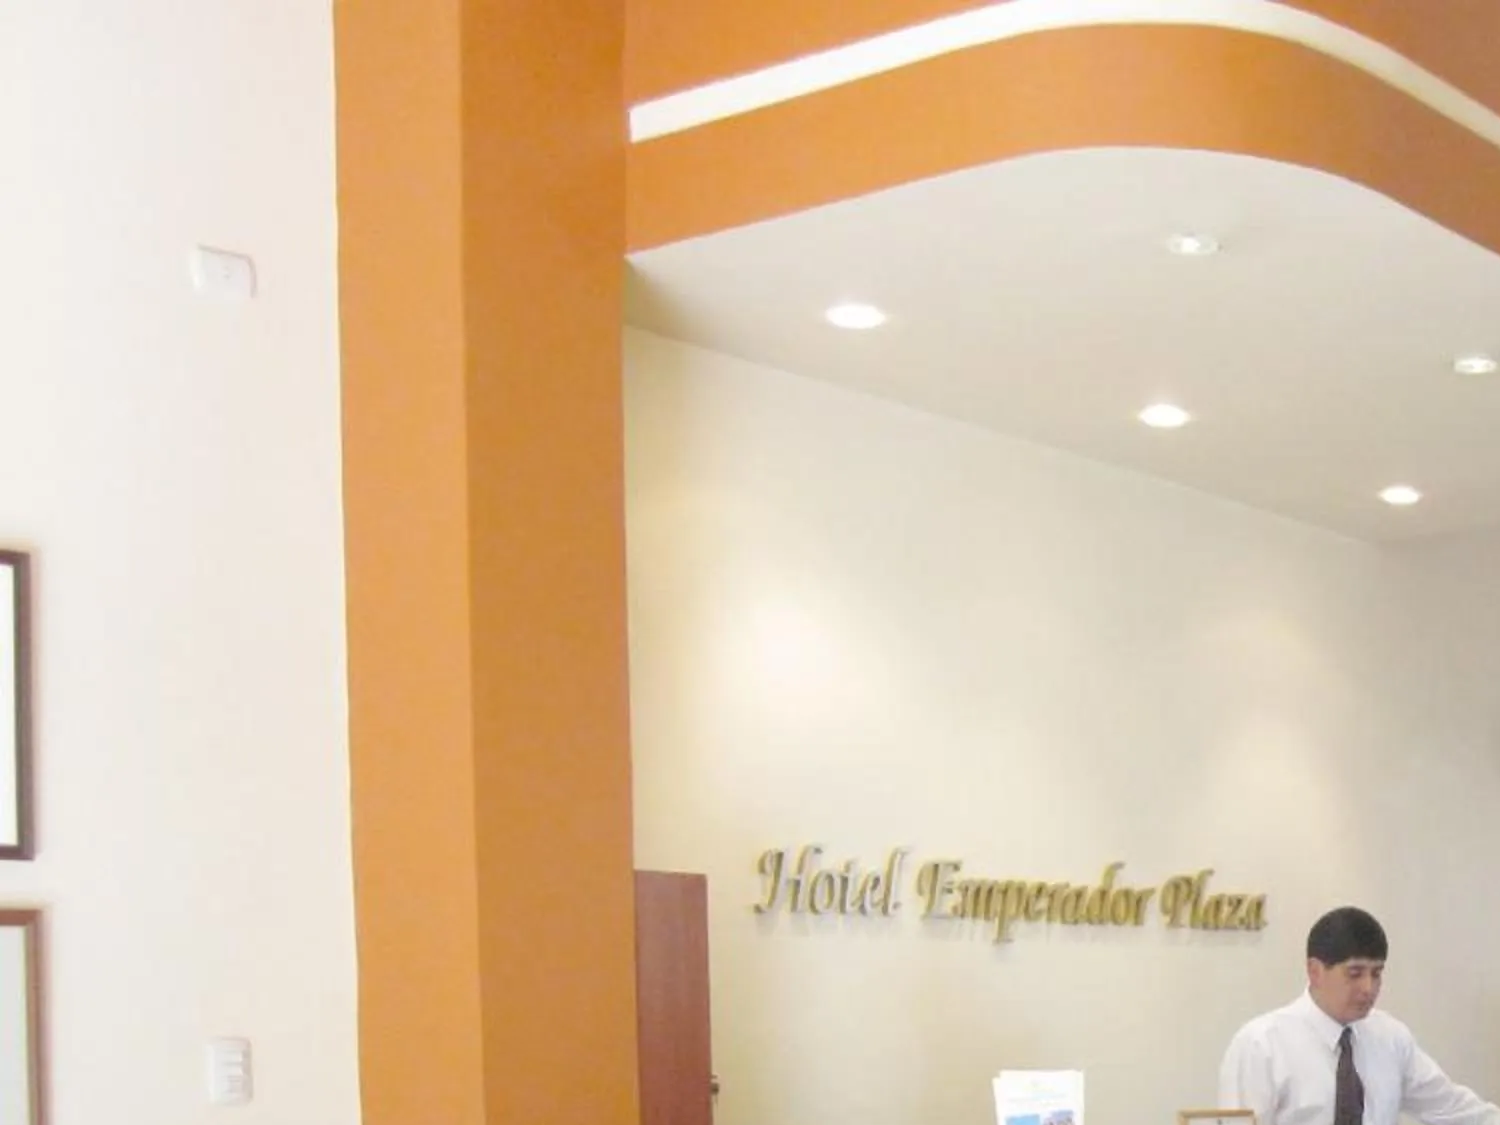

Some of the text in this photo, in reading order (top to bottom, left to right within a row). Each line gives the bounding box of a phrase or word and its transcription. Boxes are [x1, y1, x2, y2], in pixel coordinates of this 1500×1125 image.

[754, 844, 1267, 943] Hotel Emperador Plaza
